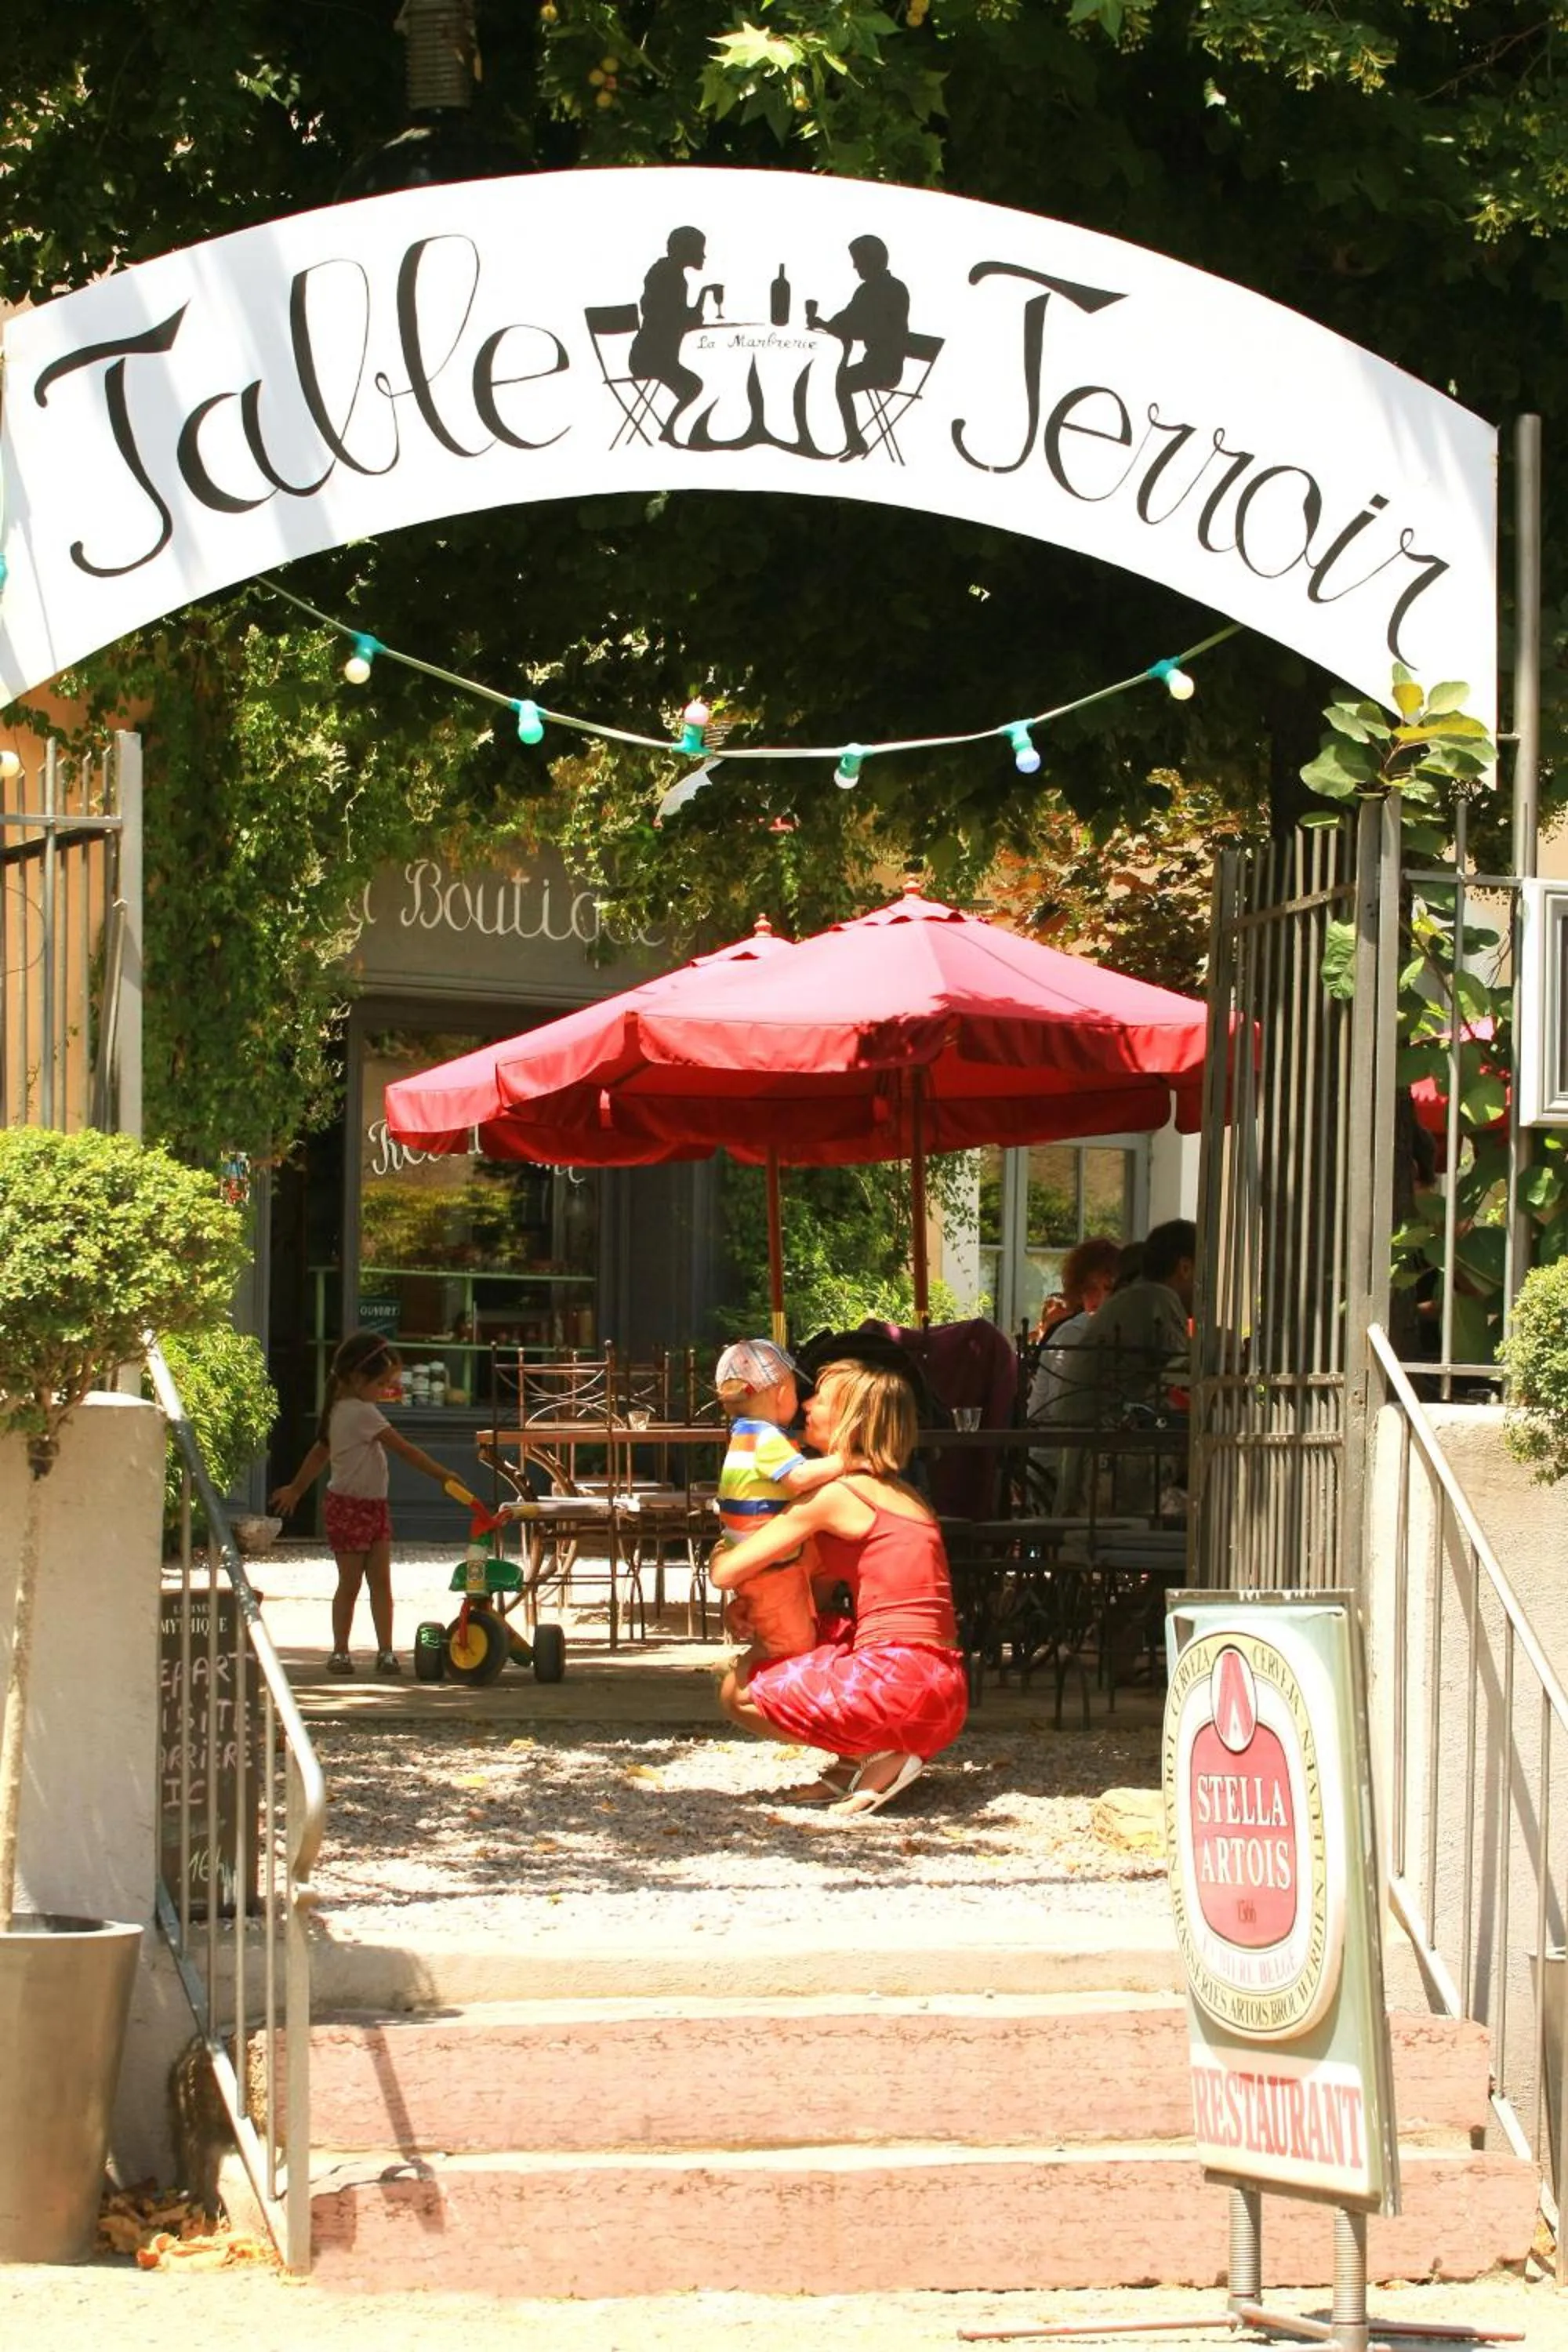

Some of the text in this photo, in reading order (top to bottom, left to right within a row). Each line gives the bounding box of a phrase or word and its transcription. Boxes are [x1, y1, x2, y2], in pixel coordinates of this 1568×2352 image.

[697, 335, 715, 349] La
[34, 233, 572, 578] Table
[951, 260, 1450, 670] Terroir
[161, 1618, 227, 1636] MYTIQE
[160, 1652, 256, 1698] EPART
[1196, 1773, 1288, 1828] STELLA
[1200, 1834, 1291, 1890] ARTOIS
[1229, 1997, 1269, 2027] ARTOIS
[1192, 2066, 1363, 2169] RESTAURANT
